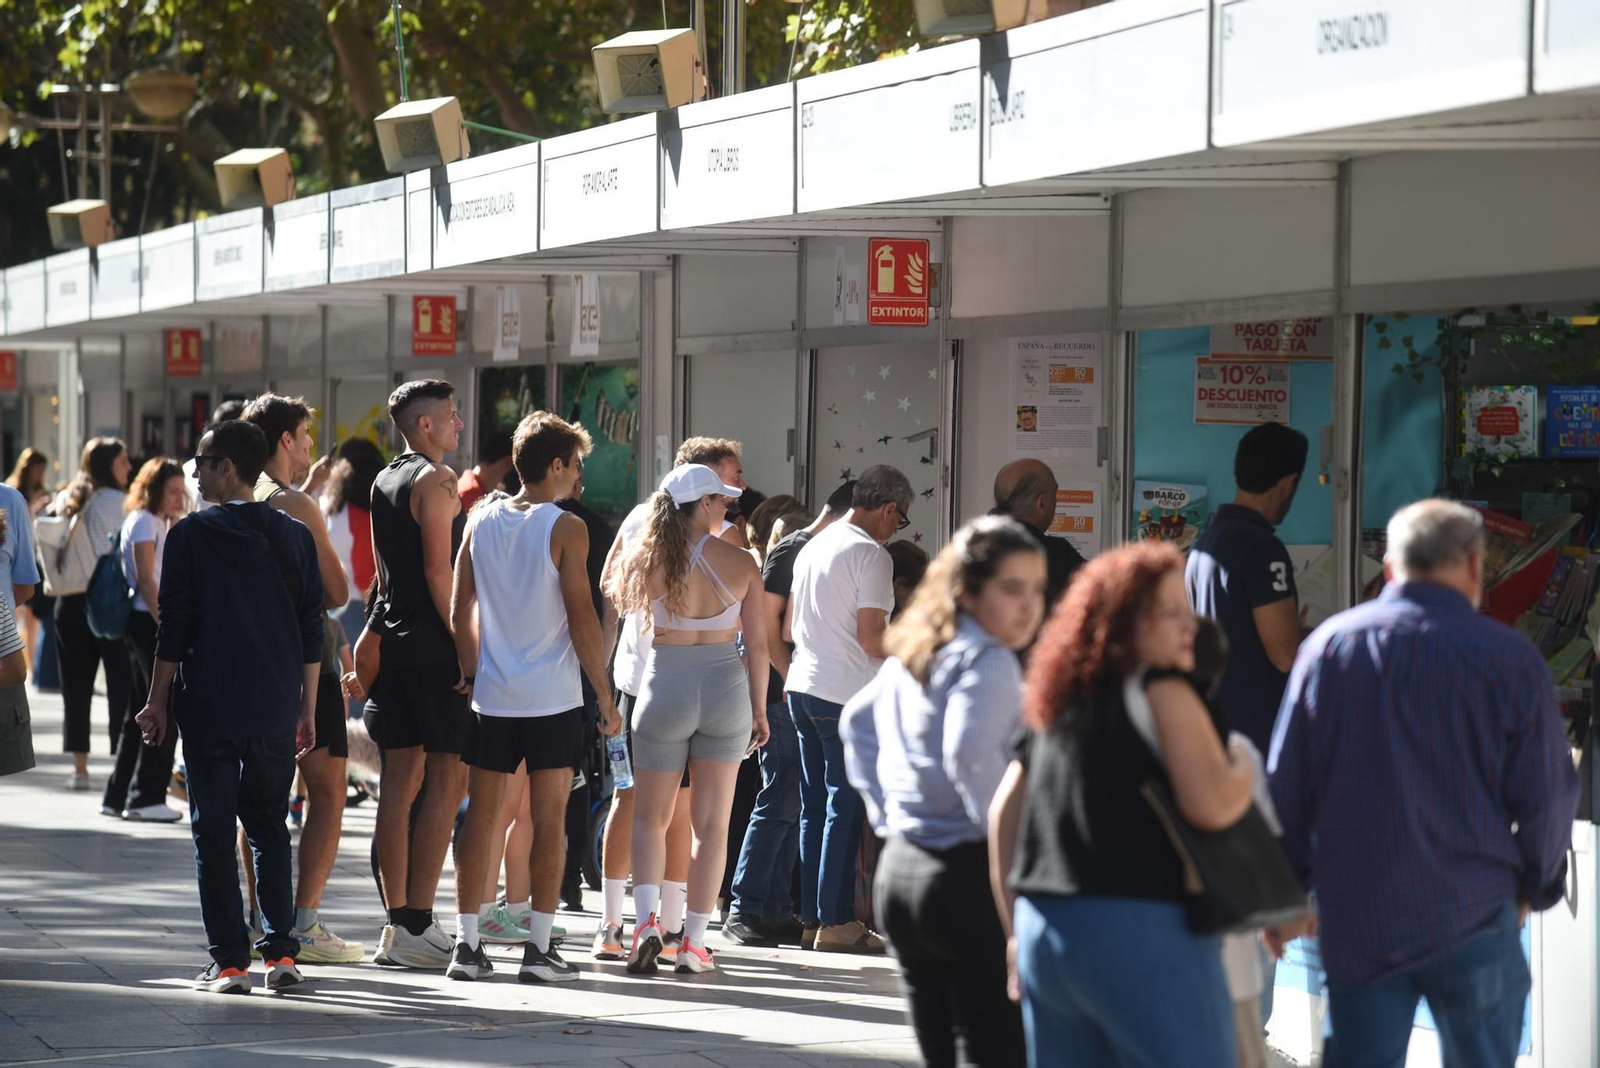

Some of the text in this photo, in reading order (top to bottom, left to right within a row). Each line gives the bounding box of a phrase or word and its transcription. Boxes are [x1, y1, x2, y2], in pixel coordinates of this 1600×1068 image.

[871, 306, 924, 317] EXTINTOR
[1234, 323, 1317, 338] PAGO CON
[1018, 341, 1045, 350] ESPAÑA
[1054, 342, 1095, 350] RECUERDO
[1244, 338, 1307, 351] TARJETA
[1219, 364, 1266, 385] 10%
[1198, 387, 1287, 403] DESCUENTO
[1216, 402, 1239, 410] TODOS
[1154, 490, 1186, 501] BARCO
[1269, 561, 1288, 591] 3
